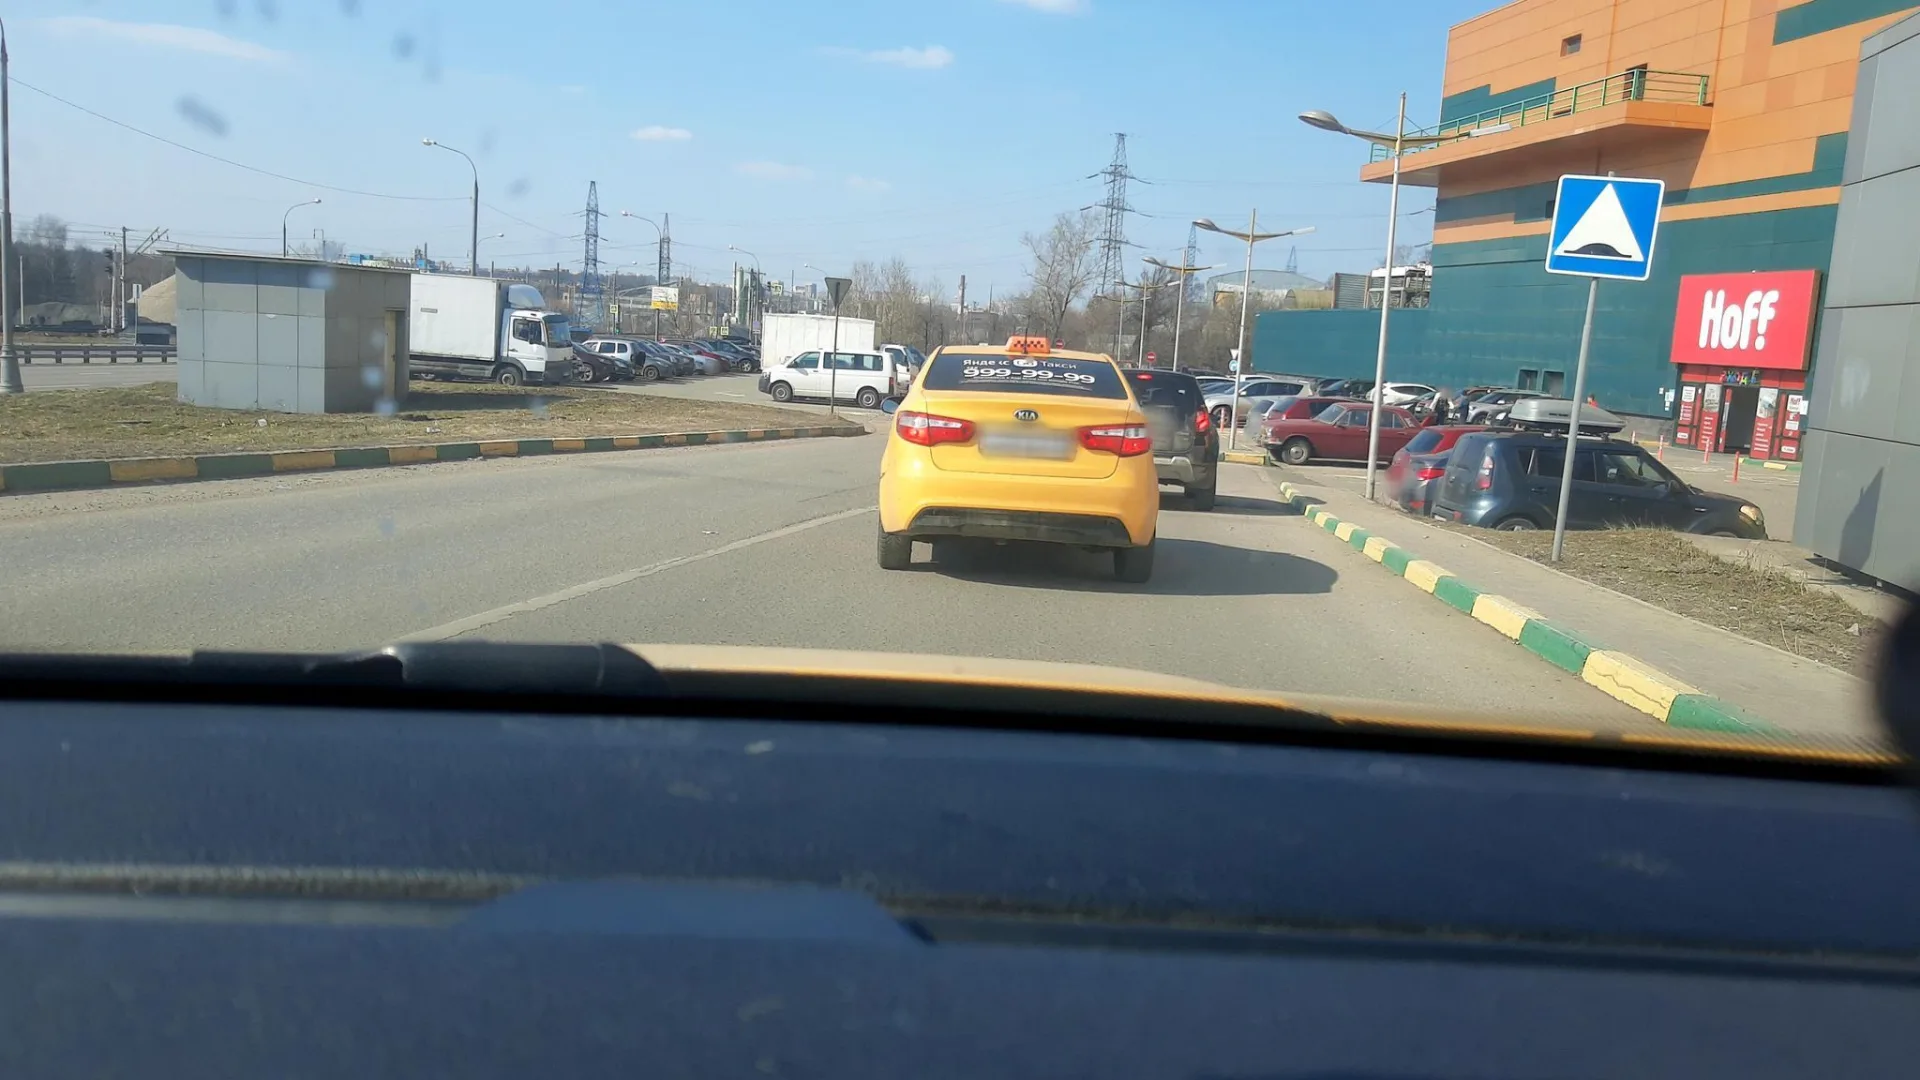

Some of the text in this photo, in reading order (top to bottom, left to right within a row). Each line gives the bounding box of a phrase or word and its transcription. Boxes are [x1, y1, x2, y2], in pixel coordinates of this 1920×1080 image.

[1698, 290, 1779, 350] Hoff
[1041, 360, 1077, 369] Такси
[963, 368, 1095, 383] 999-99-99
[1018, 411, 1036, 421] KIA
